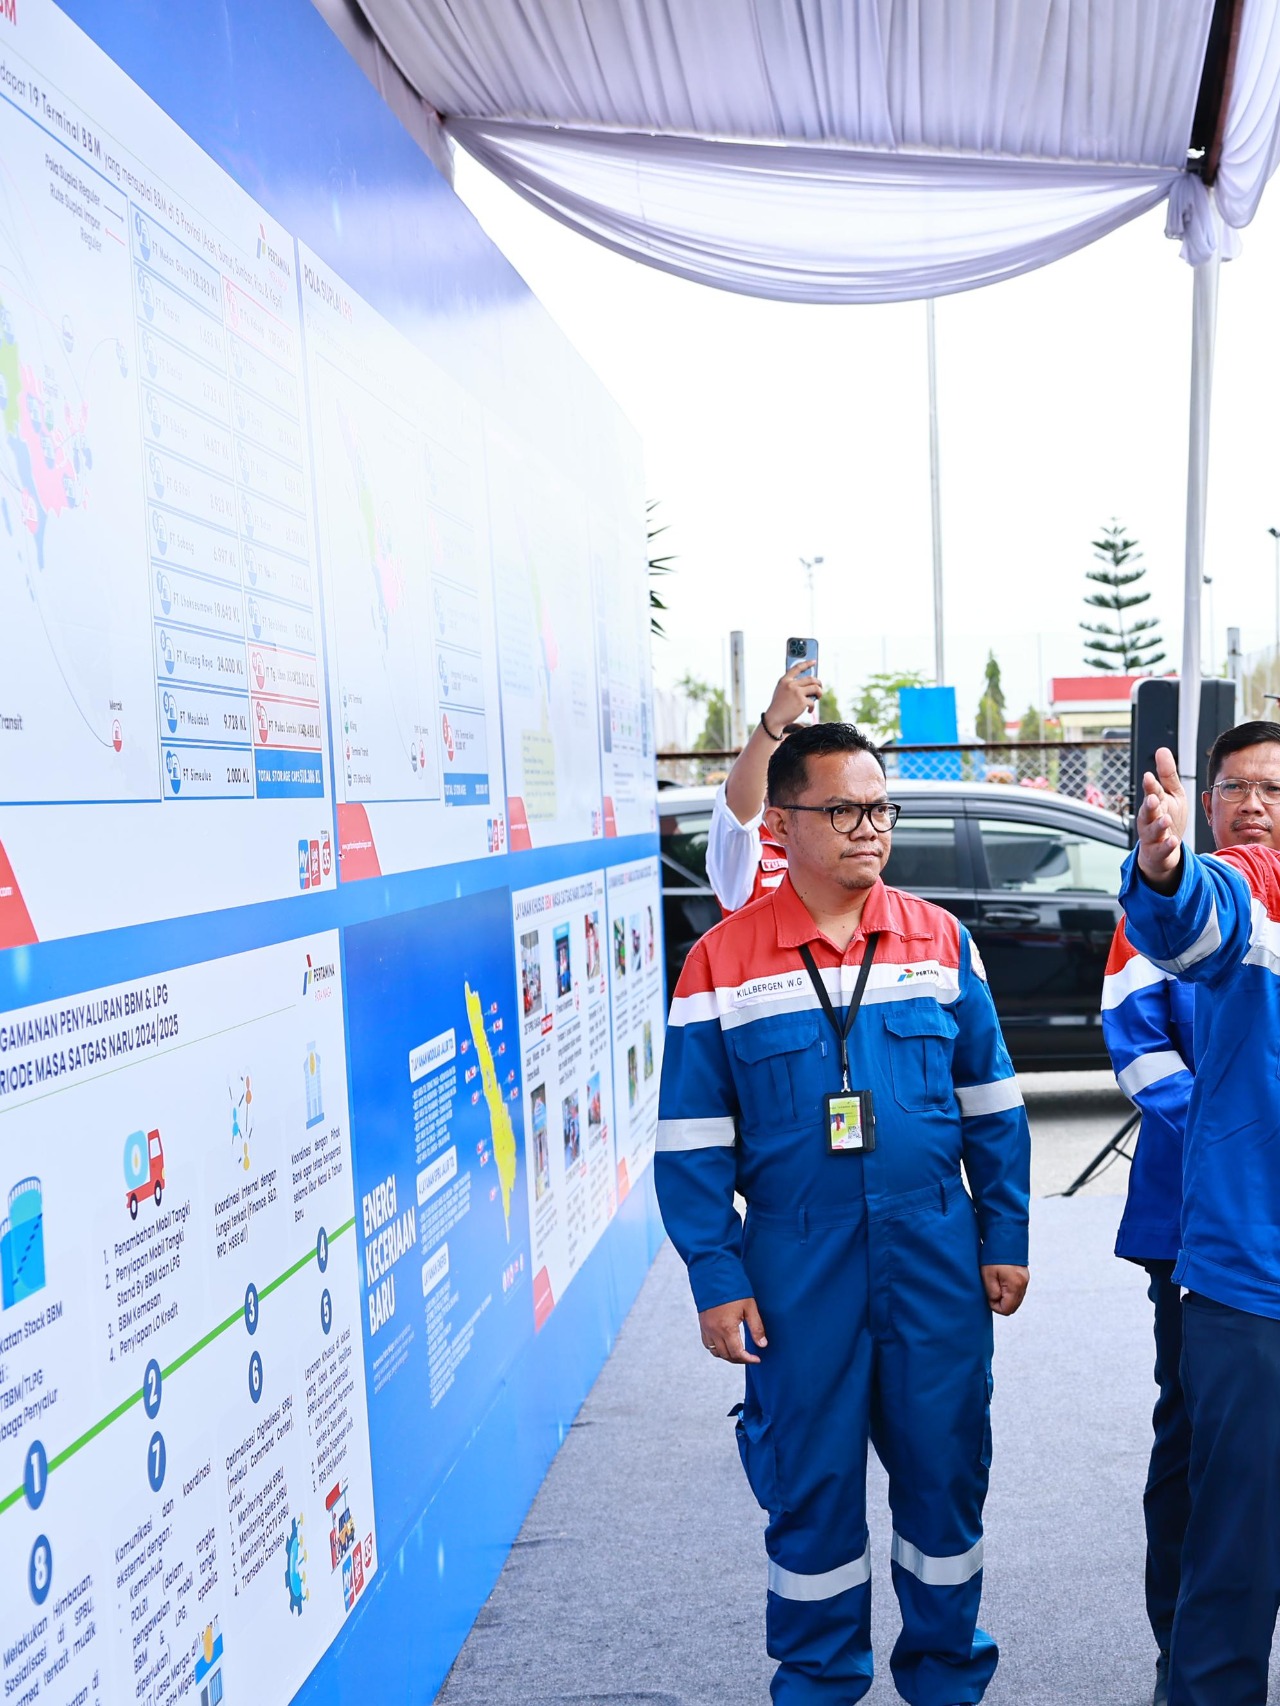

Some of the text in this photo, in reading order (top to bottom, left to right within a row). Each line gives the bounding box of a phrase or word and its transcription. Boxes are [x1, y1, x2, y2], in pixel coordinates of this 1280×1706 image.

[28, 81, 39, 108] 19
[41, 91, 80, 142] Terminal
[81, 126, 102, 160] BBM
[303, 263, 320, 298] POLA
[176, 649, 182, 664] FT
[236, 659, 244, 675] KL
[180, 710, 186, 724] FT
[239, 715, 247, 731] KL
[183, 767, 189, 781] FT
[242, 768, 250, 784] KL
[313, 963, 336, 982] PERTAMINA
[736, 977, 803, 998] KILLBERGEN W.G
[60, 996, 123, 1035] PENYALURAN
[124, 990, 144, 1017] BBM
[145, 985, 152, 1010] &
[152, 983, 169, 1007] LPG
[35, 1050, 67, 1083] MASA
[68, 1037, 107, 1072] SATGAS
[108, 1028, 135, 1058] NARU
[135, 1013, 180, 1048] 2024/2025
[214, 1169, 277, 1217] Koordinasi Internal dengan
[362, 1173, 397, 1239] ENERGI
[114, 1225, 156, 1259] Penambahan
[156, 1211, 172, 1234] Mobil
[171, 1199, 191, 1224] Tangki
[320, 1234, 326, 1261] 4
[365, 1205, 417, 1288] KECERIAAN
[116, 1253, 149, 1284] Penyiapan
[149, 1238, 165, 1262] Mobil
[165, 1226, 185, 1252] Tangki
[117, 1254, 181, 1308] Stand By BBM dan LPG
[24, 1300, 63, 1339] Stock BBM
[118, 1309, 133, 1332] BBM
[133, 1293, 162, 1322] Kemasan
[248, 1291, 255, 1323] 3
[323, 1295, 329, 1324] 5
[368, 1273, 396, 1337] BARU
[119, 1323, 153, 1357] Penyiapan
[152, 1315, 160, 1332] LO
[161, 1301, 178, 1327] Kredit
[148, 1368, 157, 1407] 2
[252, 1359, 260, 1391] 6
[24, 1388, 58, 1424] Penyalur
[31, 1452, 41, 1494] 1
[115, 1458, 212, 1564] Komunikasi dan koordinasi
[237, 1491, 263, 1526] Monitoring
[239, 1512, 265, 1548] Monitoring
[240, 1532, 266, 1568] Monitoring
[34, 1546, 49, 1590] 8
[116, 1546, 147, 1589] eksternal
[129, 1558, 163, 1602] Kemenhub
[242, 1558, 265, 1589] Transaksi
[131, 1596, 149, 1627] POLRI
[132, 1600, 171, 1655] pengawalan
[3, 1616, 48, 1671] Melakukan
[43, 1621, 96, 1687] terkait mudik
[133, 1647, 149, 1675] BBM
[4, 1640, 47, 1698] Sosialisasi
